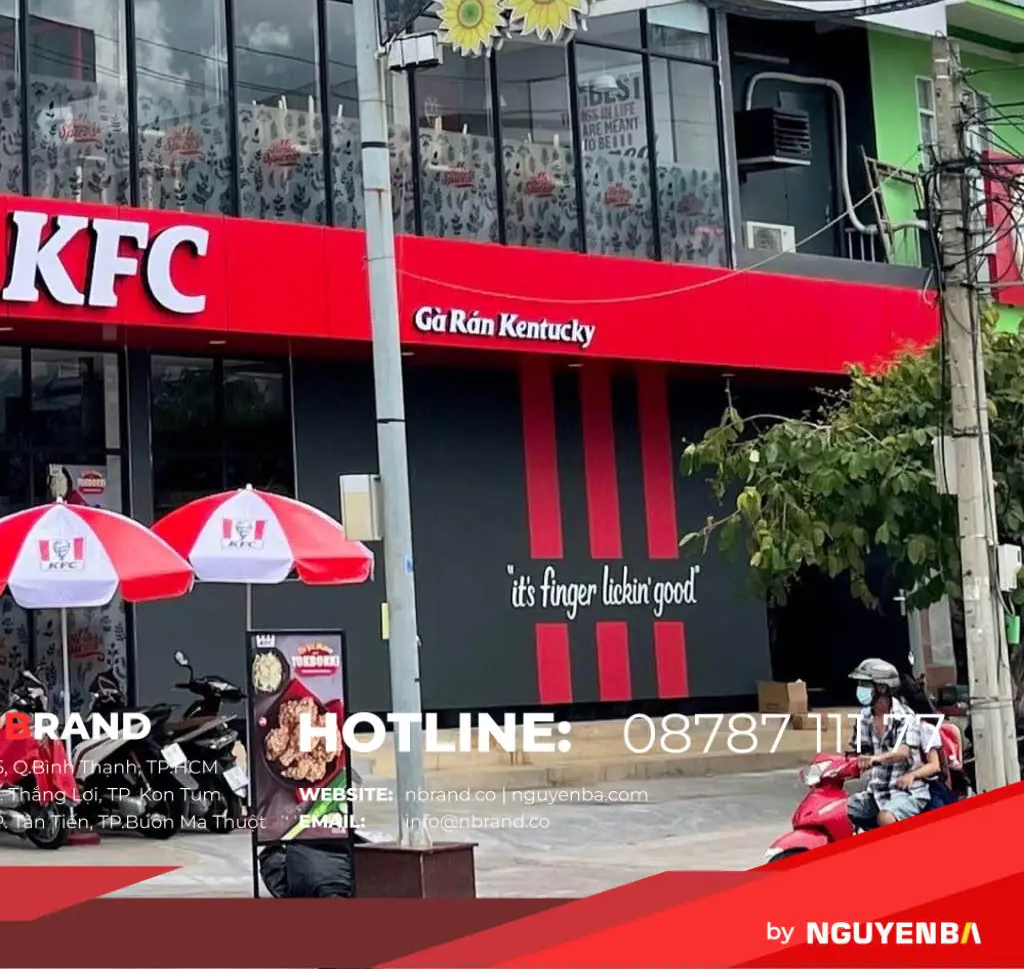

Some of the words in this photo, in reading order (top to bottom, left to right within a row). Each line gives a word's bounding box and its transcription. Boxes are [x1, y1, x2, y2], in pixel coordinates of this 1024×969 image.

[604, 117, 638, 133] MEANT
[2, 210, 210, 314] KFC
[414, 306, 448, 332] Gà
[449, 309, 495, 336] Rán
[498, 312, 596, 348] Kentucky
[48, 560, 78, 570] KFC
[540, 566, 597, 620] finger
